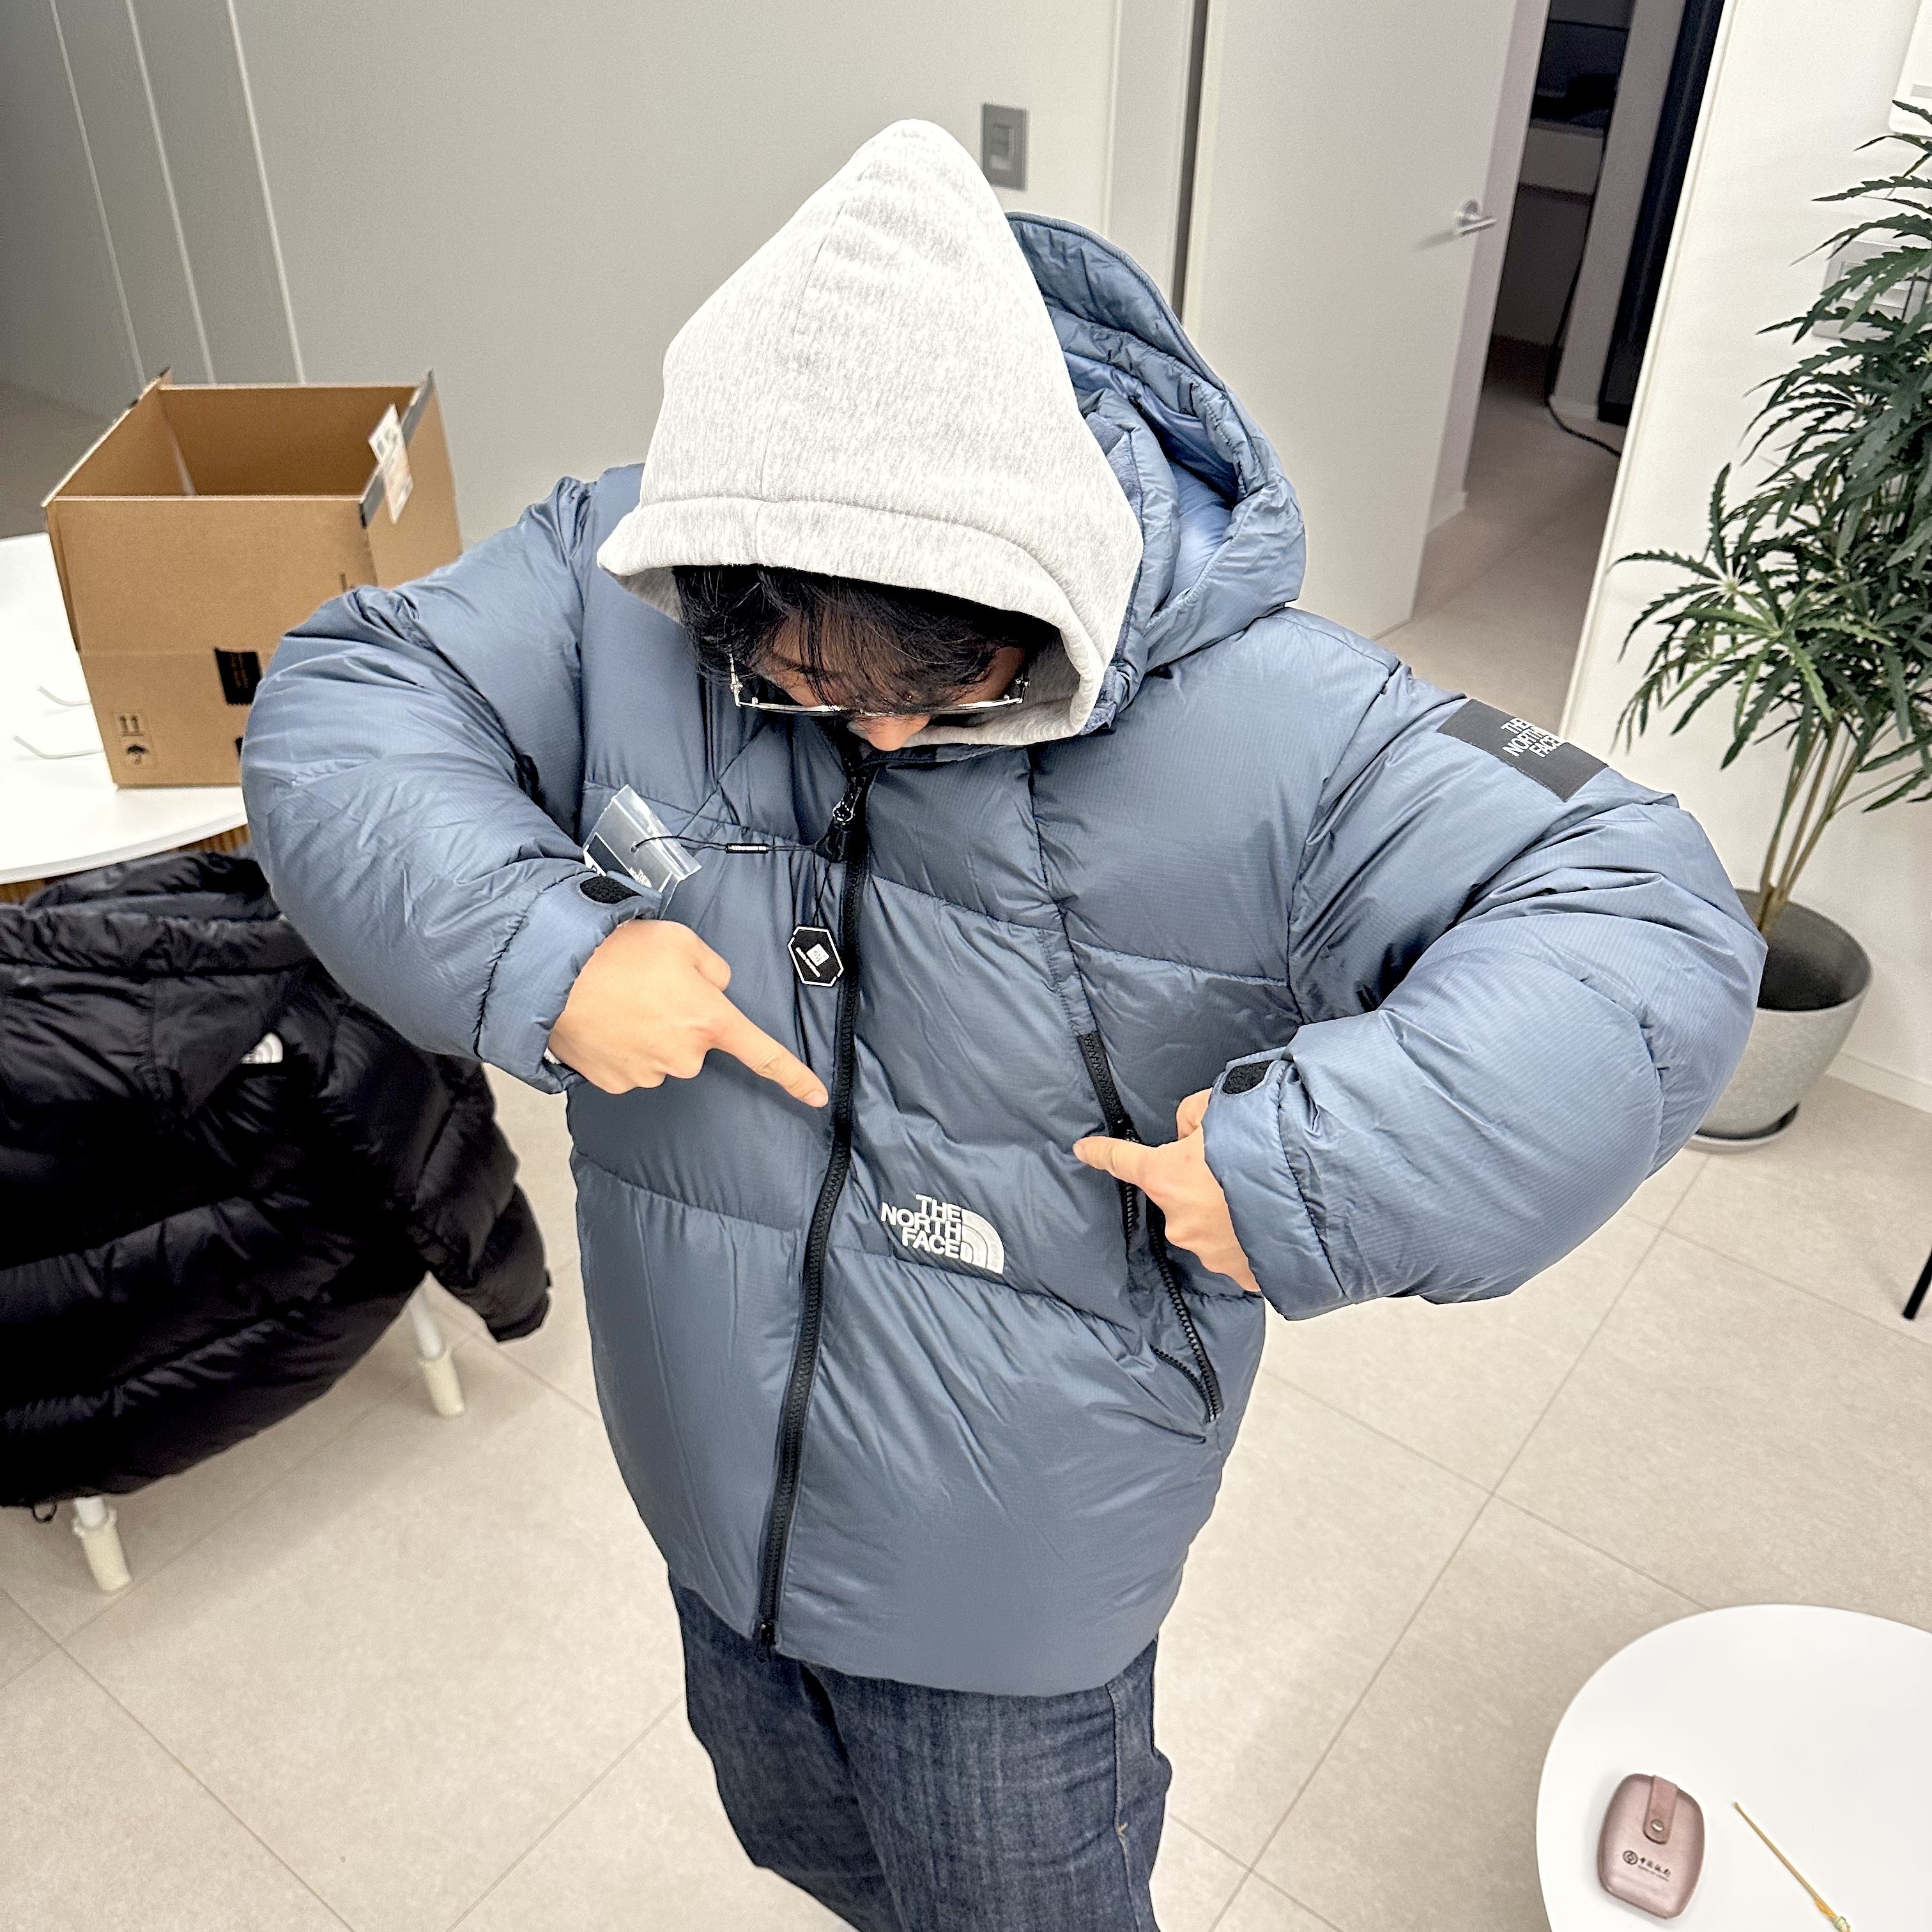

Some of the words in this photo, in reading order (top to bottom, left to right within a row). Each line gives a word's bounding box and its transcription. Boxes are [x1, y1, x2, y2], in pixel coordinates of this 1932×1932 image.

[1500, 717, 1532, 735] THE
[1503, 726, 1547, 757] NORTH
[1528, 735, 1561, 758] FACE
[881, 1202, 962, 1241] NORTH
[915, 1194, 962, 1224] THE
[901, 1226, 960, 1259] FACE
